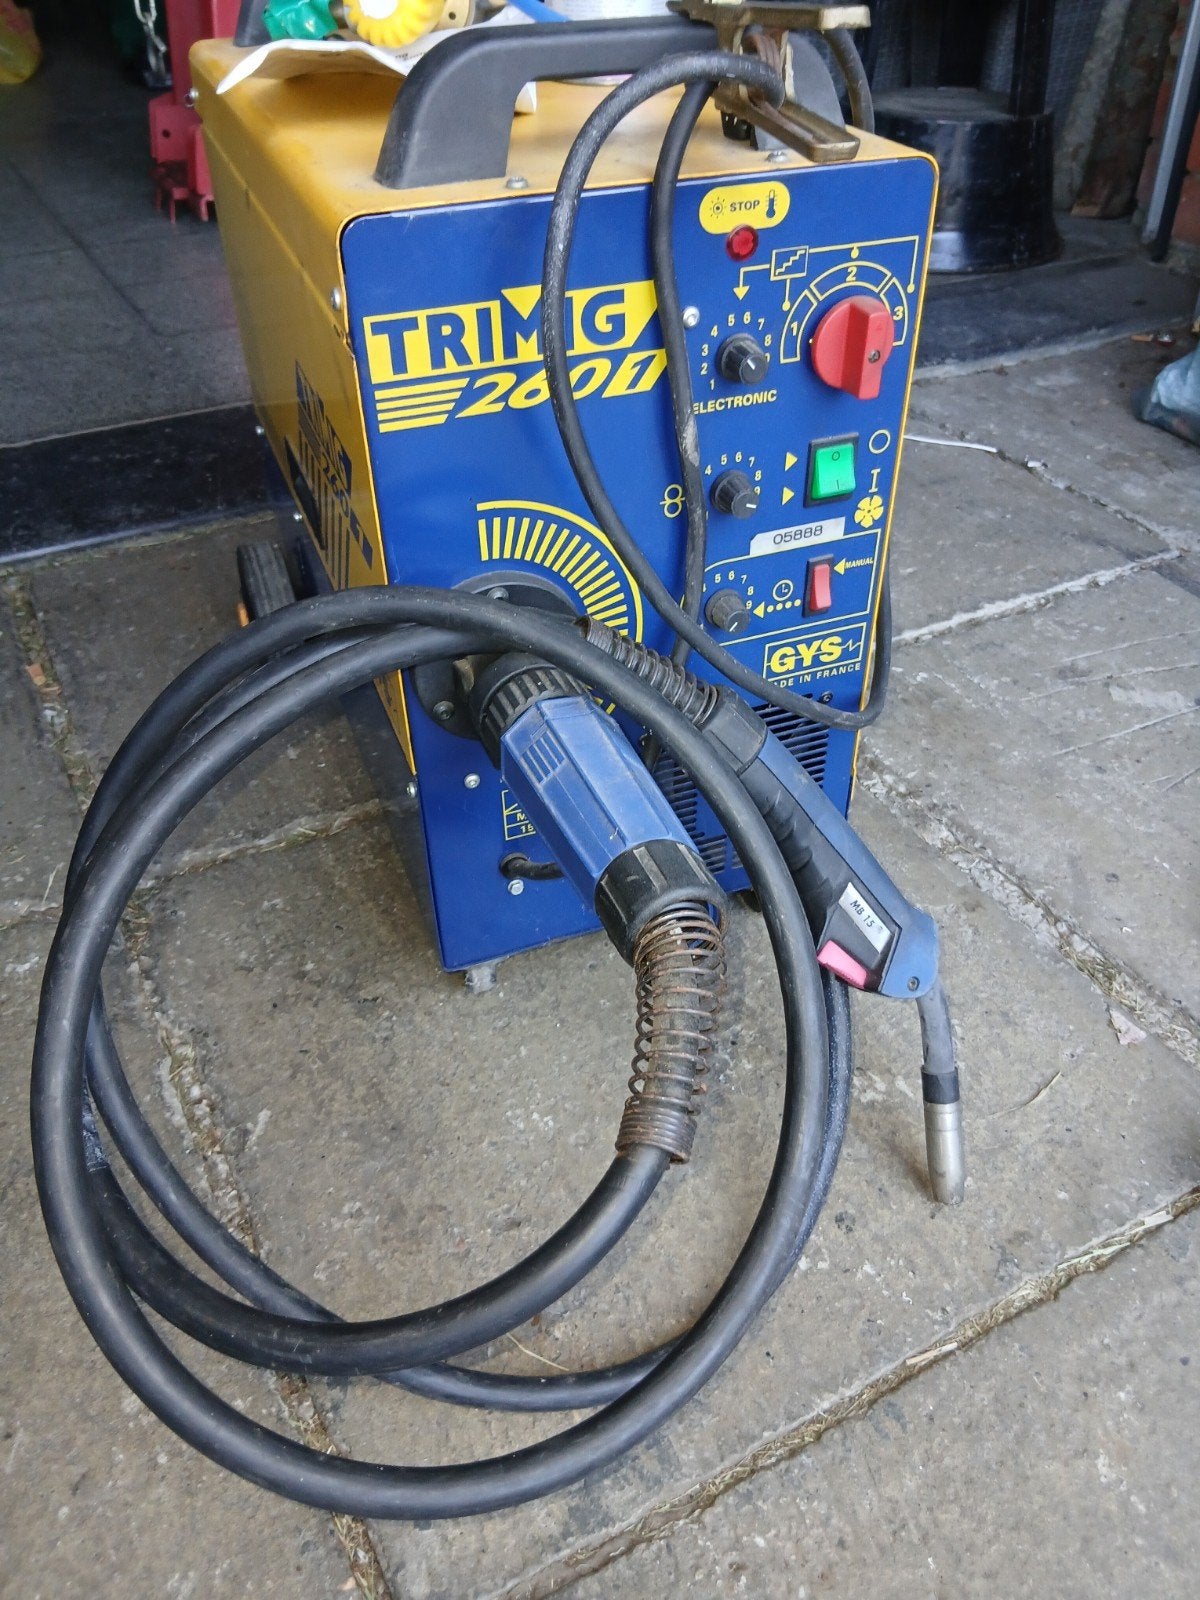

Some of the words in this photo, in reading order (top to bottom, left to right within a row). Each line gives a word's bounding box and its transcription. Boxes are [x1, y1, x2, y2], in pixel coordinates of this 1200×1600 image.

[730, 200, 760, 212] STOP
[846, 266, 856, 282] 2
[744, 311, 751, 324] 6
[893, 306, 903, 320] 3
[728, 314, 735, 327] 5
[758, 318, 765, 331] 7
[711, 325, 718, 337] 4
[791, 321, 798, 336] 1
[765, 334, 772, 347] 8
[702, 344, 709, 357] 3
[701, 363, 708, 375] 2
[693, 389, 777, 414] ELECTRONIC
[705, 464, 712, 475] 4
[721, 454, 727, 465] 5
[735, 451, 742, 462] 6
[749, 456, 755, 467] 7
[755, 470, 762, 481] 8
[844, 556, 874, 570] MANUAL
[715, 574, 721, 583] 5
[728, 570, 735, 580] 6
[741, 574, 747, 584] 7
[747, 586, 754, 595] 8
[770, 636, 842, 673] GYS
[799, 674, 811, 684] IN
[816, 663, 861, 680] FRANCE
[850, 900, 864, 916] MB
[863, 915, 875, 928] 15
